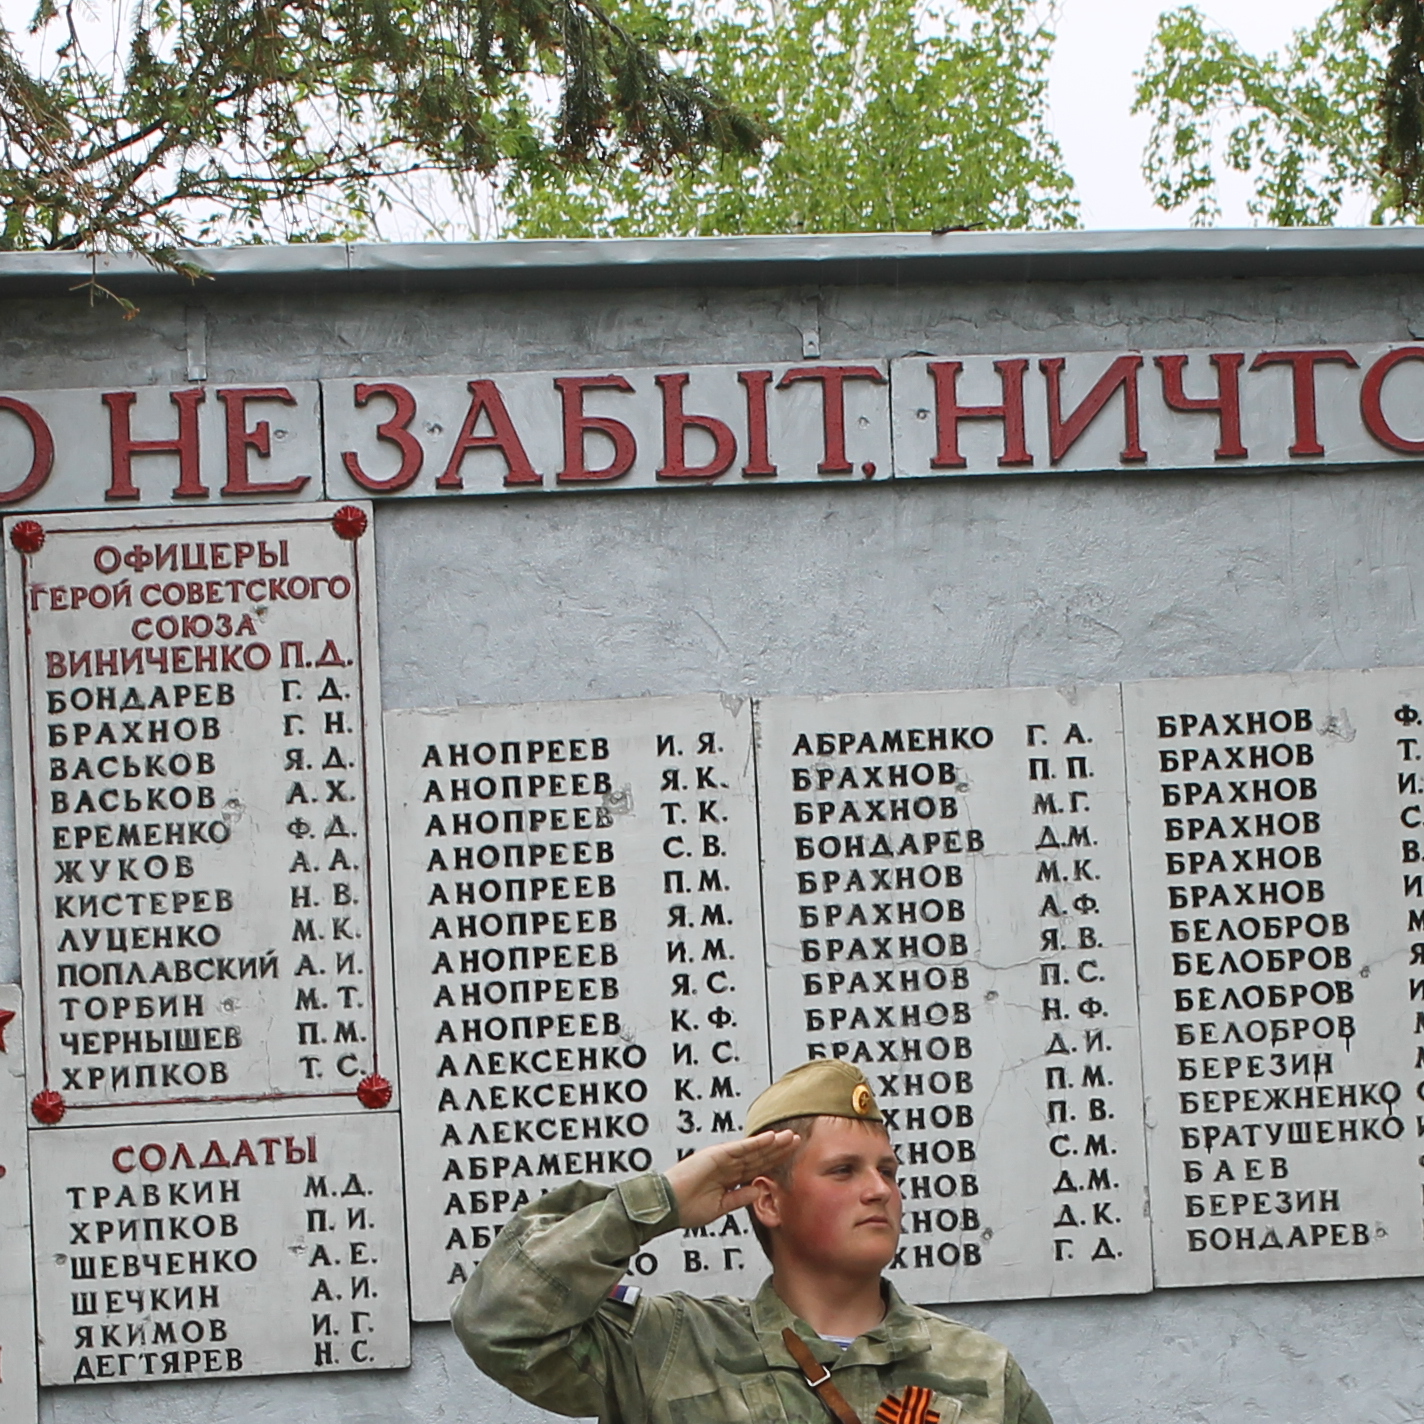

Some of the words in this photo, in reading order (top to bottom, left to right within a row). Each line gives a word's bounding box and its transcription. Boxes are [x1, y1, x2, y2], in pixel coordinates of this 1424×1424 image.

[105, 388, 304, 496] НЕ
[94, 540, 288, 574] ОФИЦЕРЫ
[30, 579, 132, 610] ГЕРОЙ
[140, 574, 352, 606] СОВЕТСКОГО
[131, 612, 258, 641] СОЮЗА
[46, 641, 272, 679] ВИНИЧЕНКО
[46, 683, 235, 715] БОНДАРЕВ
[48, 717, 220, 748] БРАХНОВ
[1157, 709, 1313, 738] БРАХНОВ
[422, 737, 609, 768] АНОПРЕЕВ
[792, 727, 993, 757] АБРАМЕНКО
[50, 752, 215, 781] ВАСЬКОВ
[1159, 743, 1314, 772] БРАХНОВ
[423, 772, 613, 803] АНОПРЕЕВ
[791, 762, 958, 791] БРАХНОВ
[51, 786, 215, 814] ВАСЬКОВ
[1161, 778, 1317, 807] БРАХНОВ
[425, 806, 613, 837] АНОПРЕЕВ
[794, 796, 958, 825] БРАХНОВ
[53, 821, 231, 850] ЕРЕМЕНКО
[1164, 812, 1320, 841] БРАХНОВ
[794, 829, 984, 860] БОНДАРЕВ
[55, 855, 194, 883] ЖУКОВ
[1165, 846, 1321, 875] БРАХНОВ
[55, 889, 233, 918] КИСТЕРЕВ
[1168, 880, 1325, 909] БРАХНОВ
[429, 909, 617, 939] АНОПРЕЕВ
[799, 899, 965, 929] БРАХНОВ
[1170, 913, 1349, 943] БЕЛОБРОВ
[57, 924, 221, 953] ЛУЦЕНКО
[57, 956, 278, 987] ПОПЛАВСКИЙ
[1172, 946, 1351, 976] БЕЛОБРОВ
[59, 994, 204, 1020] ТОРБИН
[1173, 980, 1354, 1012] БЕЛОБРОВ
[435, 1012, 621, 1044] АНОПРЕЕВ
[804, 1002, 971, 1032] БРАХНОВ
[1175, 1016, 1355, 1046] БЕЛОБРОВ
[60, 1026, 242, 1055] ЧЕРНЫШЕВ
[62, 1061, 228, 1091] ХРИПКОВ
[436, 1044, 646, 1078] АЛЕКСЕНКО
[1177, 1053, 1333, 1081] БЕРЕЗИН
[438, 1079, 647, 1112] АЛЕКСЕНКО
[1179, 1081, 1403, 1114] БЕРЕЖНЕНКО
[440, 1112, 649, 1147] АЛЕКСЕНКО
[1180, 1114, 1405, 1152] БРАТУШЕНКО
[115, 1138, 314, 1171] СОЛДАТЫ
[442, 1147, 652, 1181] АБРАМЕНКО
[1183, 1157, 1288, 1183] БАЕВ
[66, 1179, 240, 1209] ТРАВКИН
[1185, 1190, 1339, 1217] БЕРЕЗИН
[70, 1214, 238, 1245] ХРИПКОВ
[1187, 1224, 1369, 1252] БОНДАРЕВ
[69, 1248, 257, 1279] ШЕВЧЕНКО
[71, 1285, 219, 1315] ШЕЧКИН
[75, 1319, 227, 1349] ЯКИМОВ
[74, 1348, 242, 1381] ДЕГТЯРЕВ
